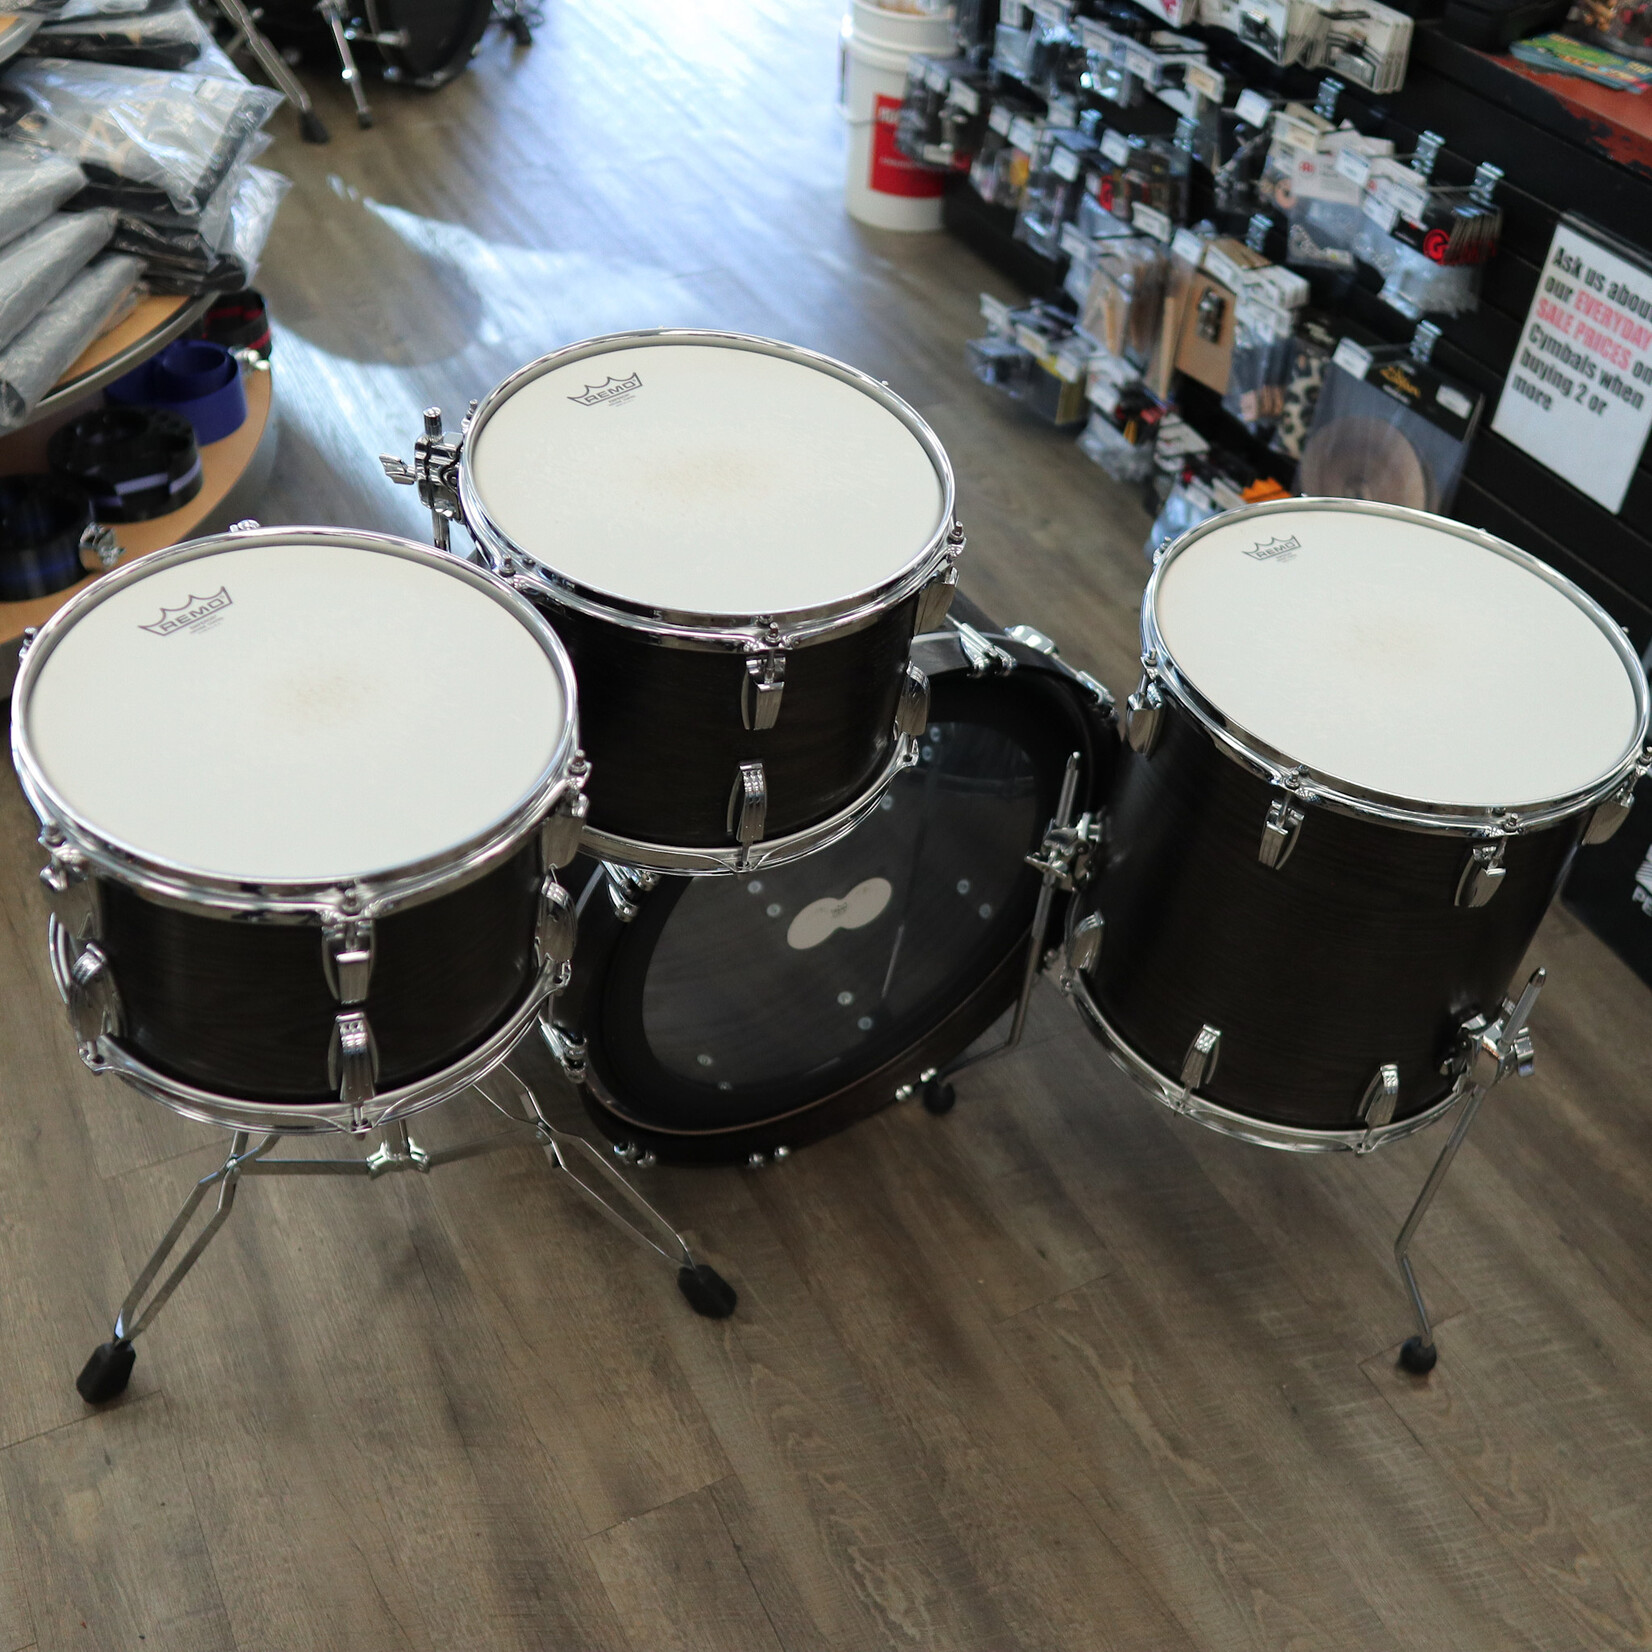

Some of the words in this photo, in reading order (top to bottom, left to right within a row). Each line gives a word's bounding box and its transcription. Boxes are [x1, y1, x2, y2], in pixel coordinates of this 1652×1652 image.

[1553, 246, 1583, 279] Ask
[1584, 267, 1606, 293] us
[1537, 297, 1575, 335] SALE
[1573, 321, 1632, 371] PRICES
[1544, 276, 1574, 303] our
[1574, 289, 1652, 351] EVERYDAY
[1520, 346, 1574, 397] buying
[1575, 382, 1588, 405] 2
[1588, 395, 1608, 417] or
[1528, 323, 1597, 379] Cymbals
[1599, 369, 1645, 411] when
[584, 380, 637, 403] REMO
[1511, 374, 1553, 411] more
[1256, 541, 1296, 558] REMO
[160, 597, 225, 632] REMO
